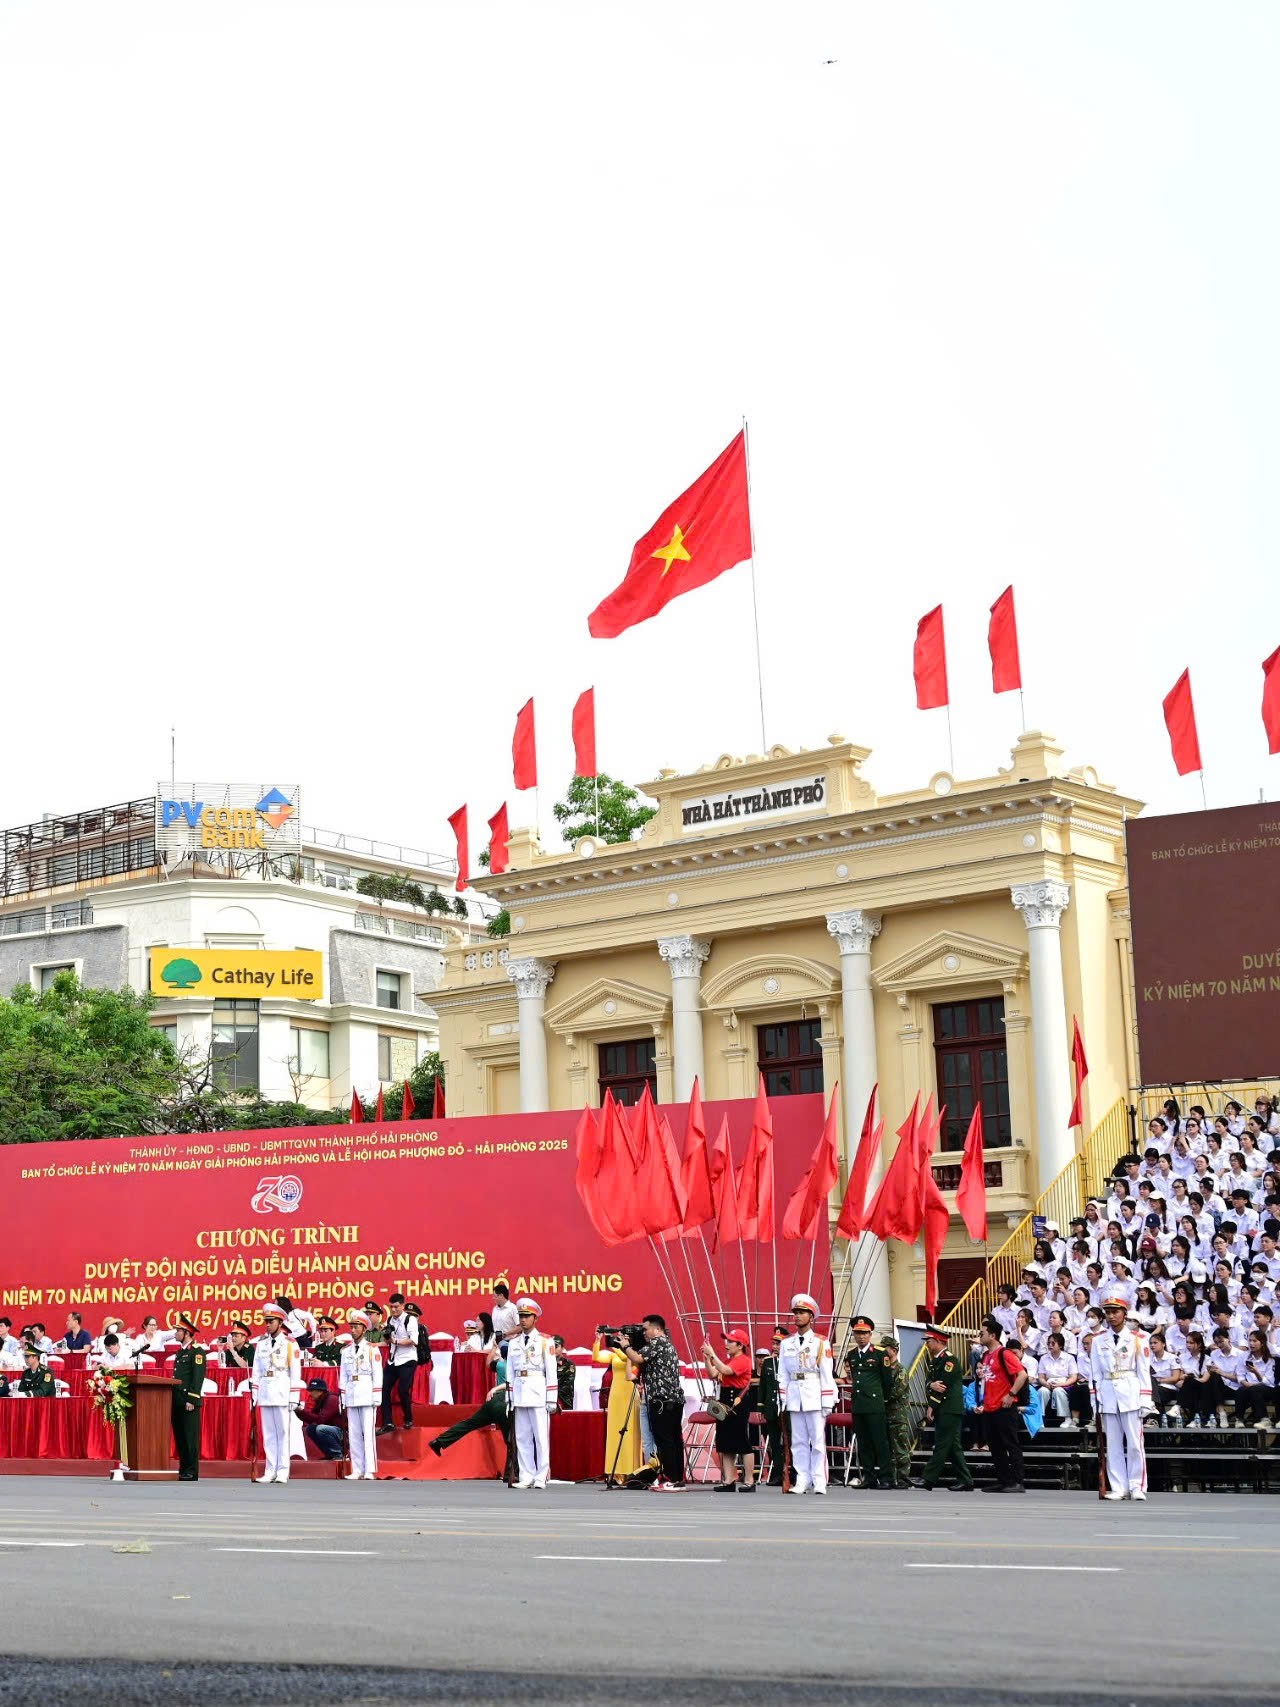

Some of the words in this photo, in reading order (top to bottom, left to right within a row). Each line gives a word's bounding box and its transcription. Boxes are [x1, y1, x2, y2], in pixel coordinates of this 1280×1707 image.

[682, 800, 712, 826] NHÀ
[713, 794, 741, 819] HÁT
[741, 788, 792, 815] THÀNH
[793, 777, 826, 805] PHỐ
[202, 828, 267, 849] Bank
[212, 968, 275, 988] Cathay
[281, 969, 314, 985] Life
[1144, 981, 1163, 1001] KỶ
[1168, 980, 1205, 1003] NIỆM
[1207, 981, 1227, 996] 70
[1230, 974, 1266, 994] NĂM
[21, 1168, 41, 1179] BAN
[43, 1163, 56, 1177] TỔ
[57, 1163, 84, 1176] CHỨC
[85, 1161, 97, 1175] LỄ
[98, 1162, 112, 1174] KỶ
[113, 1161, 137, 1176] NIỆM
[138, 1163, 150, 1172] 70
[152, 1159, 174, 1171] NĂM
[175, 1158, 203, 1171] NGÀY
[205, 1156, 226, 1169] GIẢI
[227, 1155, 262, 1168] PHÓNG
[264, 1153, 282, 1166] HẢI
[283, 1151, 320, 1165] PHÒNG
[322, 1149, 336, 1163] VÀ
[338, 1146, 351, 1162] LỄ
[353, 1147, 372, 1164] HỘI
[374, 1150, 397, 1160] HOA
[399, 1146, 445, 1162] PHƯỢNG
[447, 1143, 465, 1156] ĐỎ
[475, 1141, 494, 1155] HẢI
[495, 1138, 537, 1153] PHÒNG
[538, 1139, 568, 1151] 2025
[130, 1146, 162, 1158] THÀNH
[163, 1145, 177, 1157] ỦY
[186, 1145, 214, 1155] HĐND
[223, 1143, 251, 1153] UBND
[260, 1138, 316, 1151] UBMTTQVN
[318, 1135, 354, 1147] THÀNH
[355, 1131, 378, 1145] PHỐ
[380, 1132, 398, 1144] HẢI
[400, 1130, 438, 1143] PHÒNG
[251, 1175, 303, 1213] 70
[196, 1226, 286, 1249] CHƯƠNG
[291, 1221, 359, 1245] TRÌNH
[85, 1258, 140, 1282] DUYỆT
[145, 1257, 177, 1281] ĐỘI
[181, 1256, 219, 1276] NGŨ
[222, 1253, 247, 1275] VÀ
[251, 1249, 294, 1275] DIỄU
[297, 1249, 351, 1273] HÀNH
[354, 1246, 410, 1272] QUẦN
[414, 1247, 486, 1269] CHÚNG
[2, 1286, 42, 1310] NIỆM
[45, 1289, 66, 1305] 70
[69, 1283, 108, 1304] NĂM
[111, 1280, 160, 1303] NGÀY
[163, 1279, 200, 1302] GIẢI
[202, 1278, 267, 1301] PHÓNG
[271, 1276, 302, 1300] HẢI
[306, 1274, 375, 1299] PHÒNG
[394, 1273, 467, 1297] THÀNH
[514, 1275, 558, 1294] ANH
[562, 1270, 624, 1293] HÙNG
